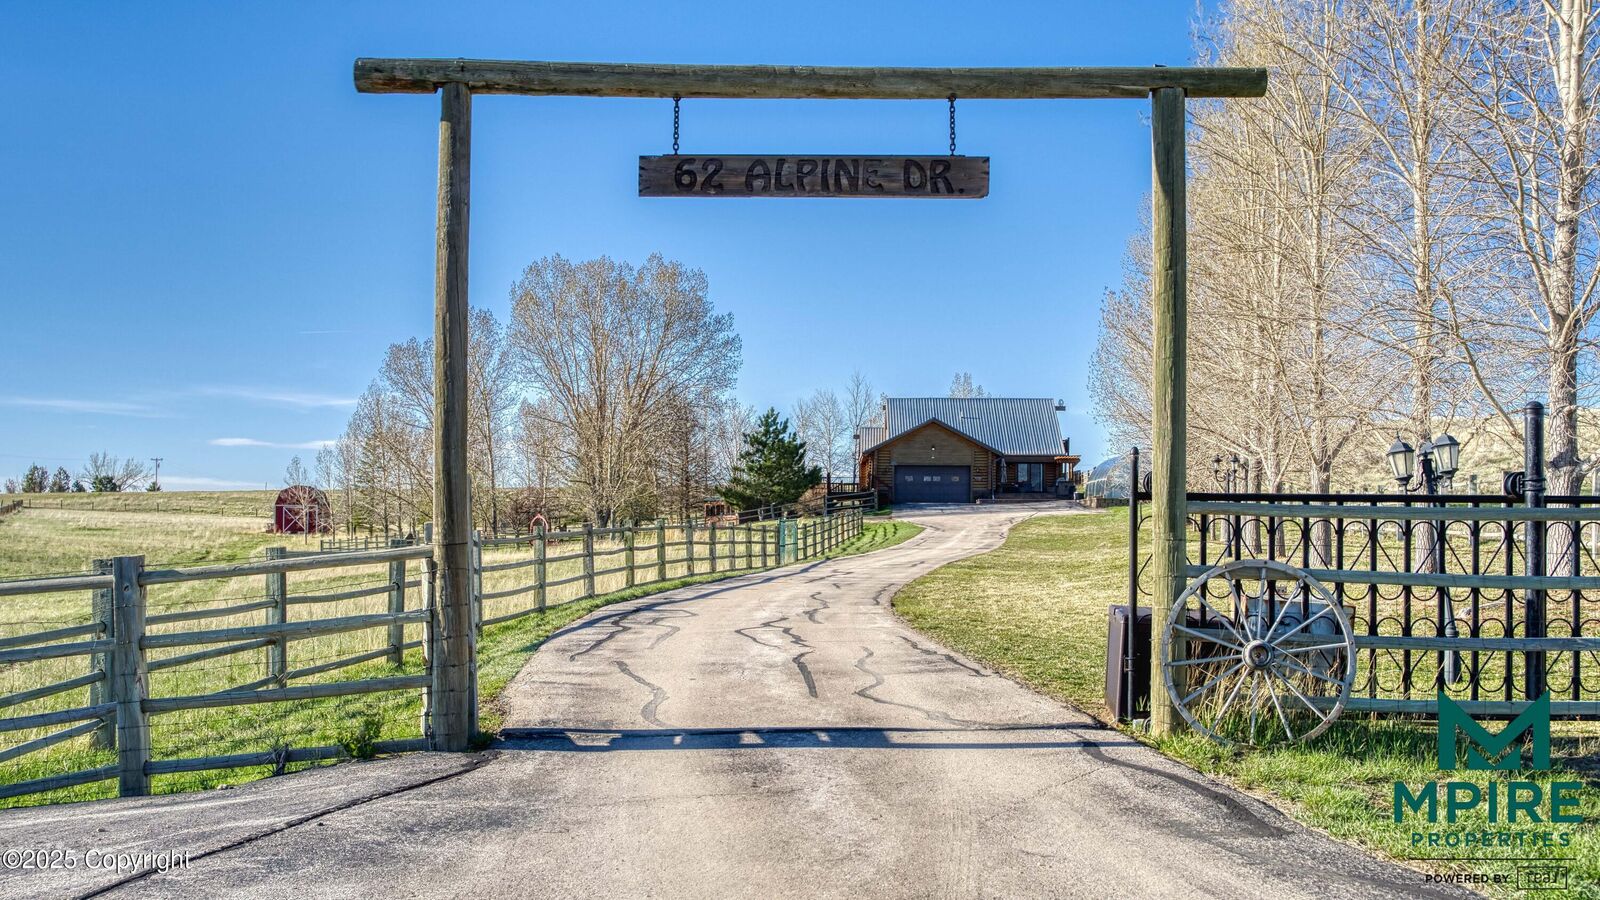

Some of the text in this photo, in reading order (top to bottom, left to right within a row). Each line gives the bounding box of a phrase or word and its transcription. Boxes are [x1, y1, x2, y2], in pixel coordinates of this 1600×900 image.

[674, 157, 966, 194] 62 ALPINE DR.
